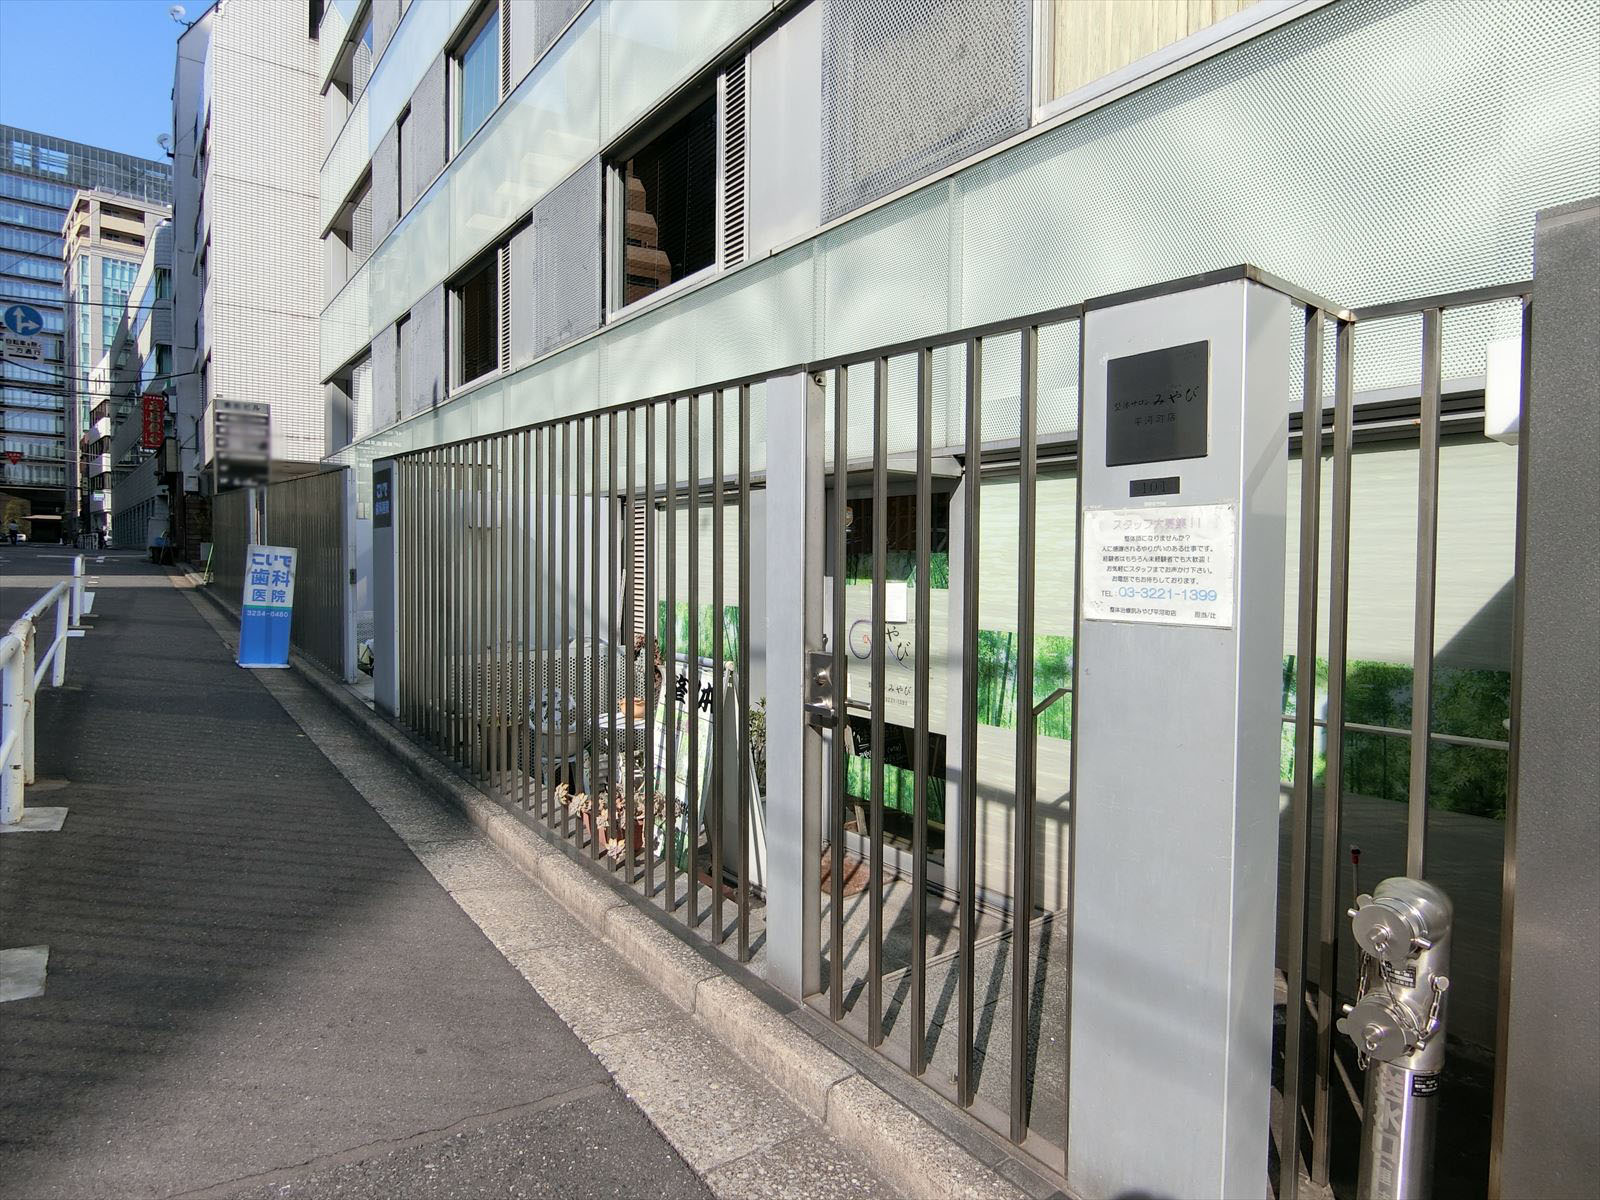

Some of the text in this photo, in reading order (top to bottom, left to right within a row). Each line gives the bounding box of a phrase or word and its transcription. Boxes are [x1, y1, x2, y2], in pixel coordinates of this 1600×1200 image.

[251, 552, 292, 568] こいで
[251, 568, 290, 587] 歯科
[252, 588, 286, 603] 医院
[1119, 586, 1217, 601] 03-3221-1399
